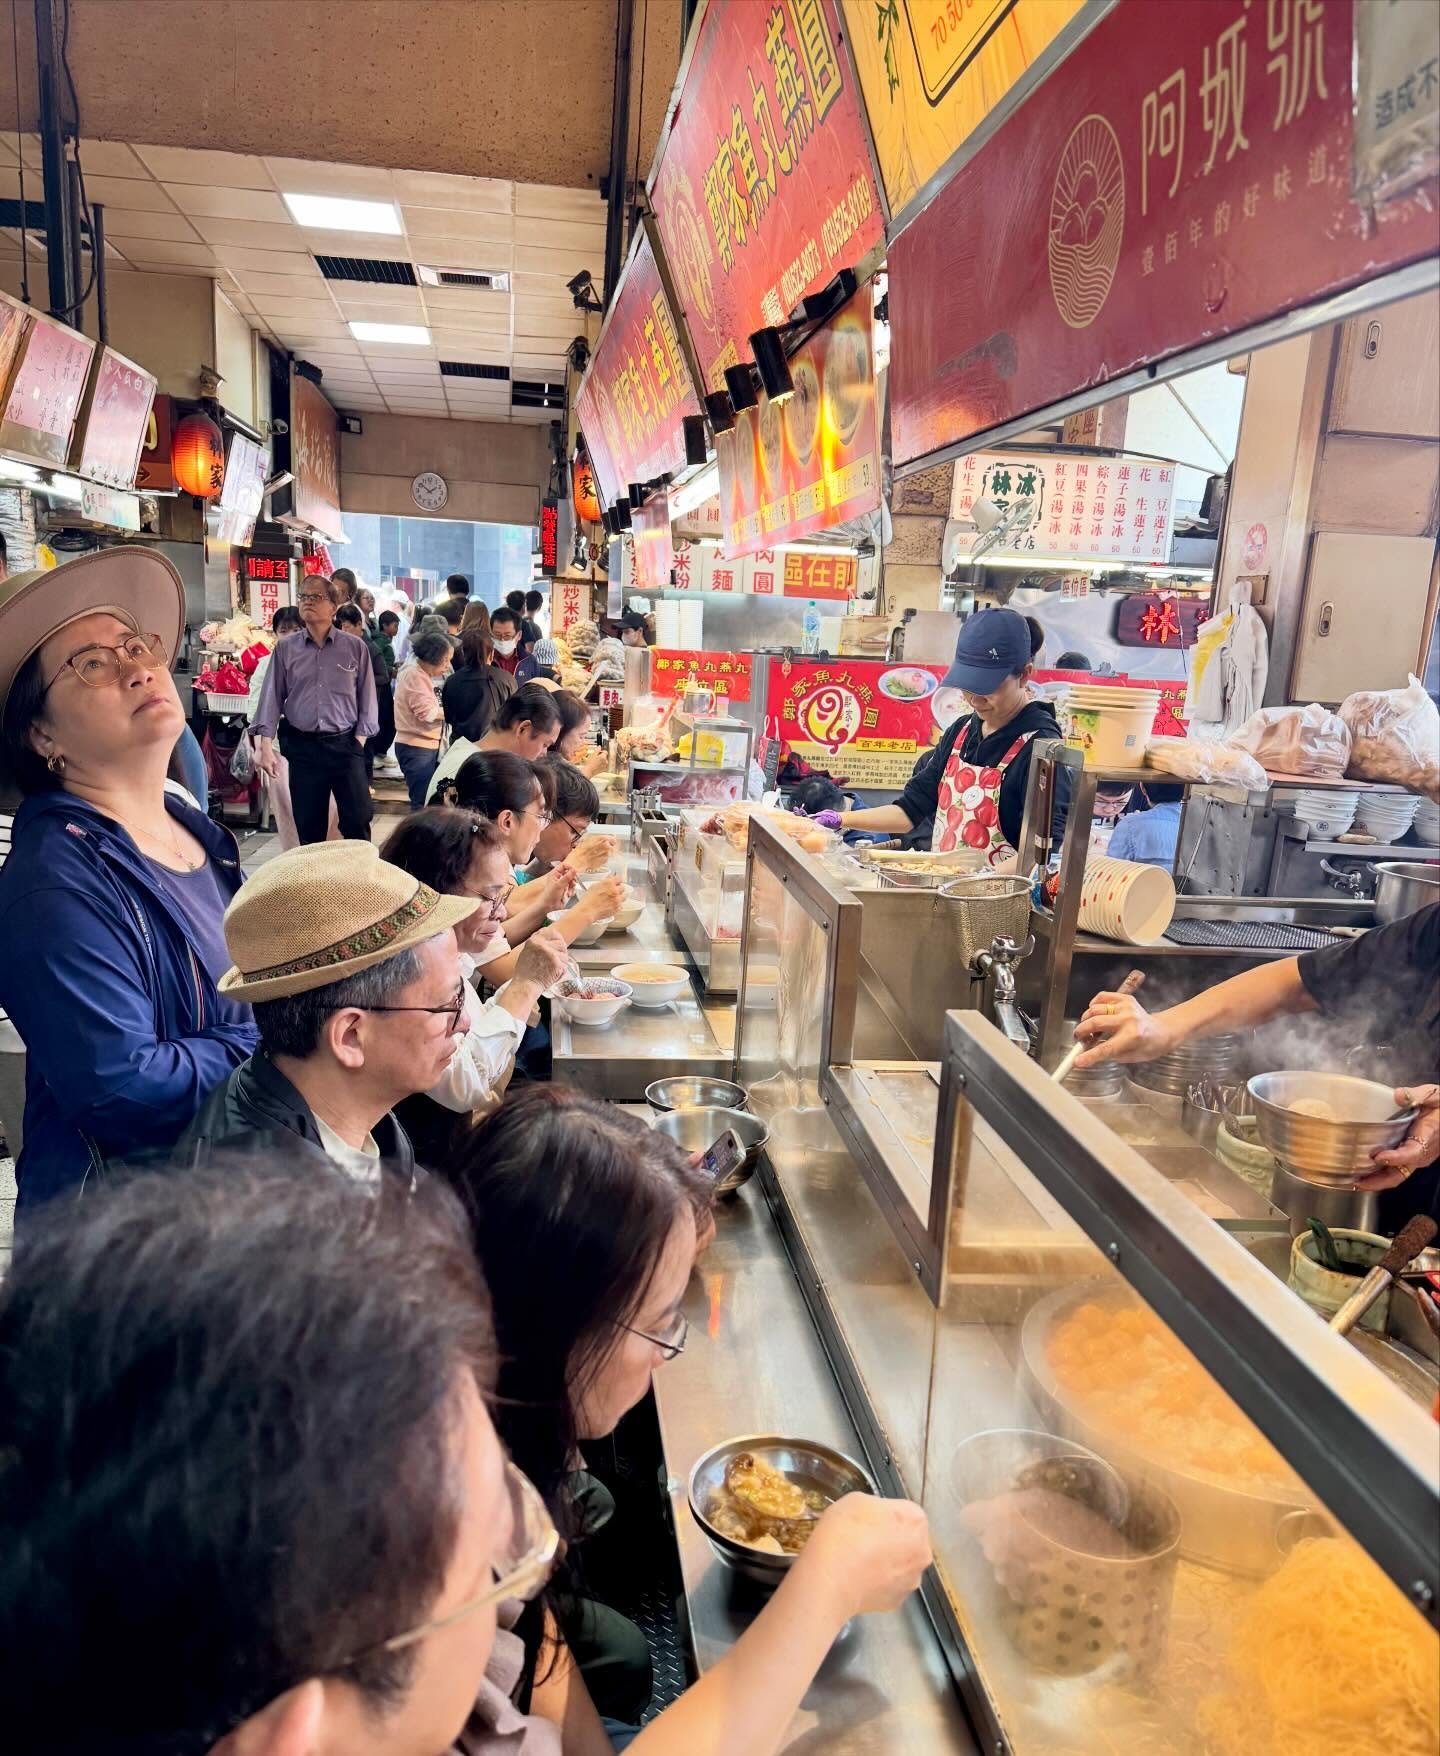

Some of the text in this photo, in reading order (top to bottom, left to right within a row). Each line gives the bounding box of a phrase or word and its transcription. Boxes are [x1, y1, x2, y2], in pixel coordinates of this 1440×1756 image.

[930, 15, 947, 52] 70
[703, 0, 844, 272] 鄭家魚丸燕圓
[1141, 0, 1328, 216] 阿城號
[1140, 143, 1329, 278] 壹佰年的好味道
[1049, 462, 1068, 535] 紅豆(湯)冰
[1069, 463, 1089, 536] 四果(湯)冰
[1090, 464, 1110, 537] 綜合(湯)冰
[1111, 466, 1131, 538] 蓮子(湯)冰
[1133, 467, 1152, 543] 花生蓮子
[1153, 469, 1172, 544] 紅豆蓮子
[860, 739, 914, 751] 百年老店
